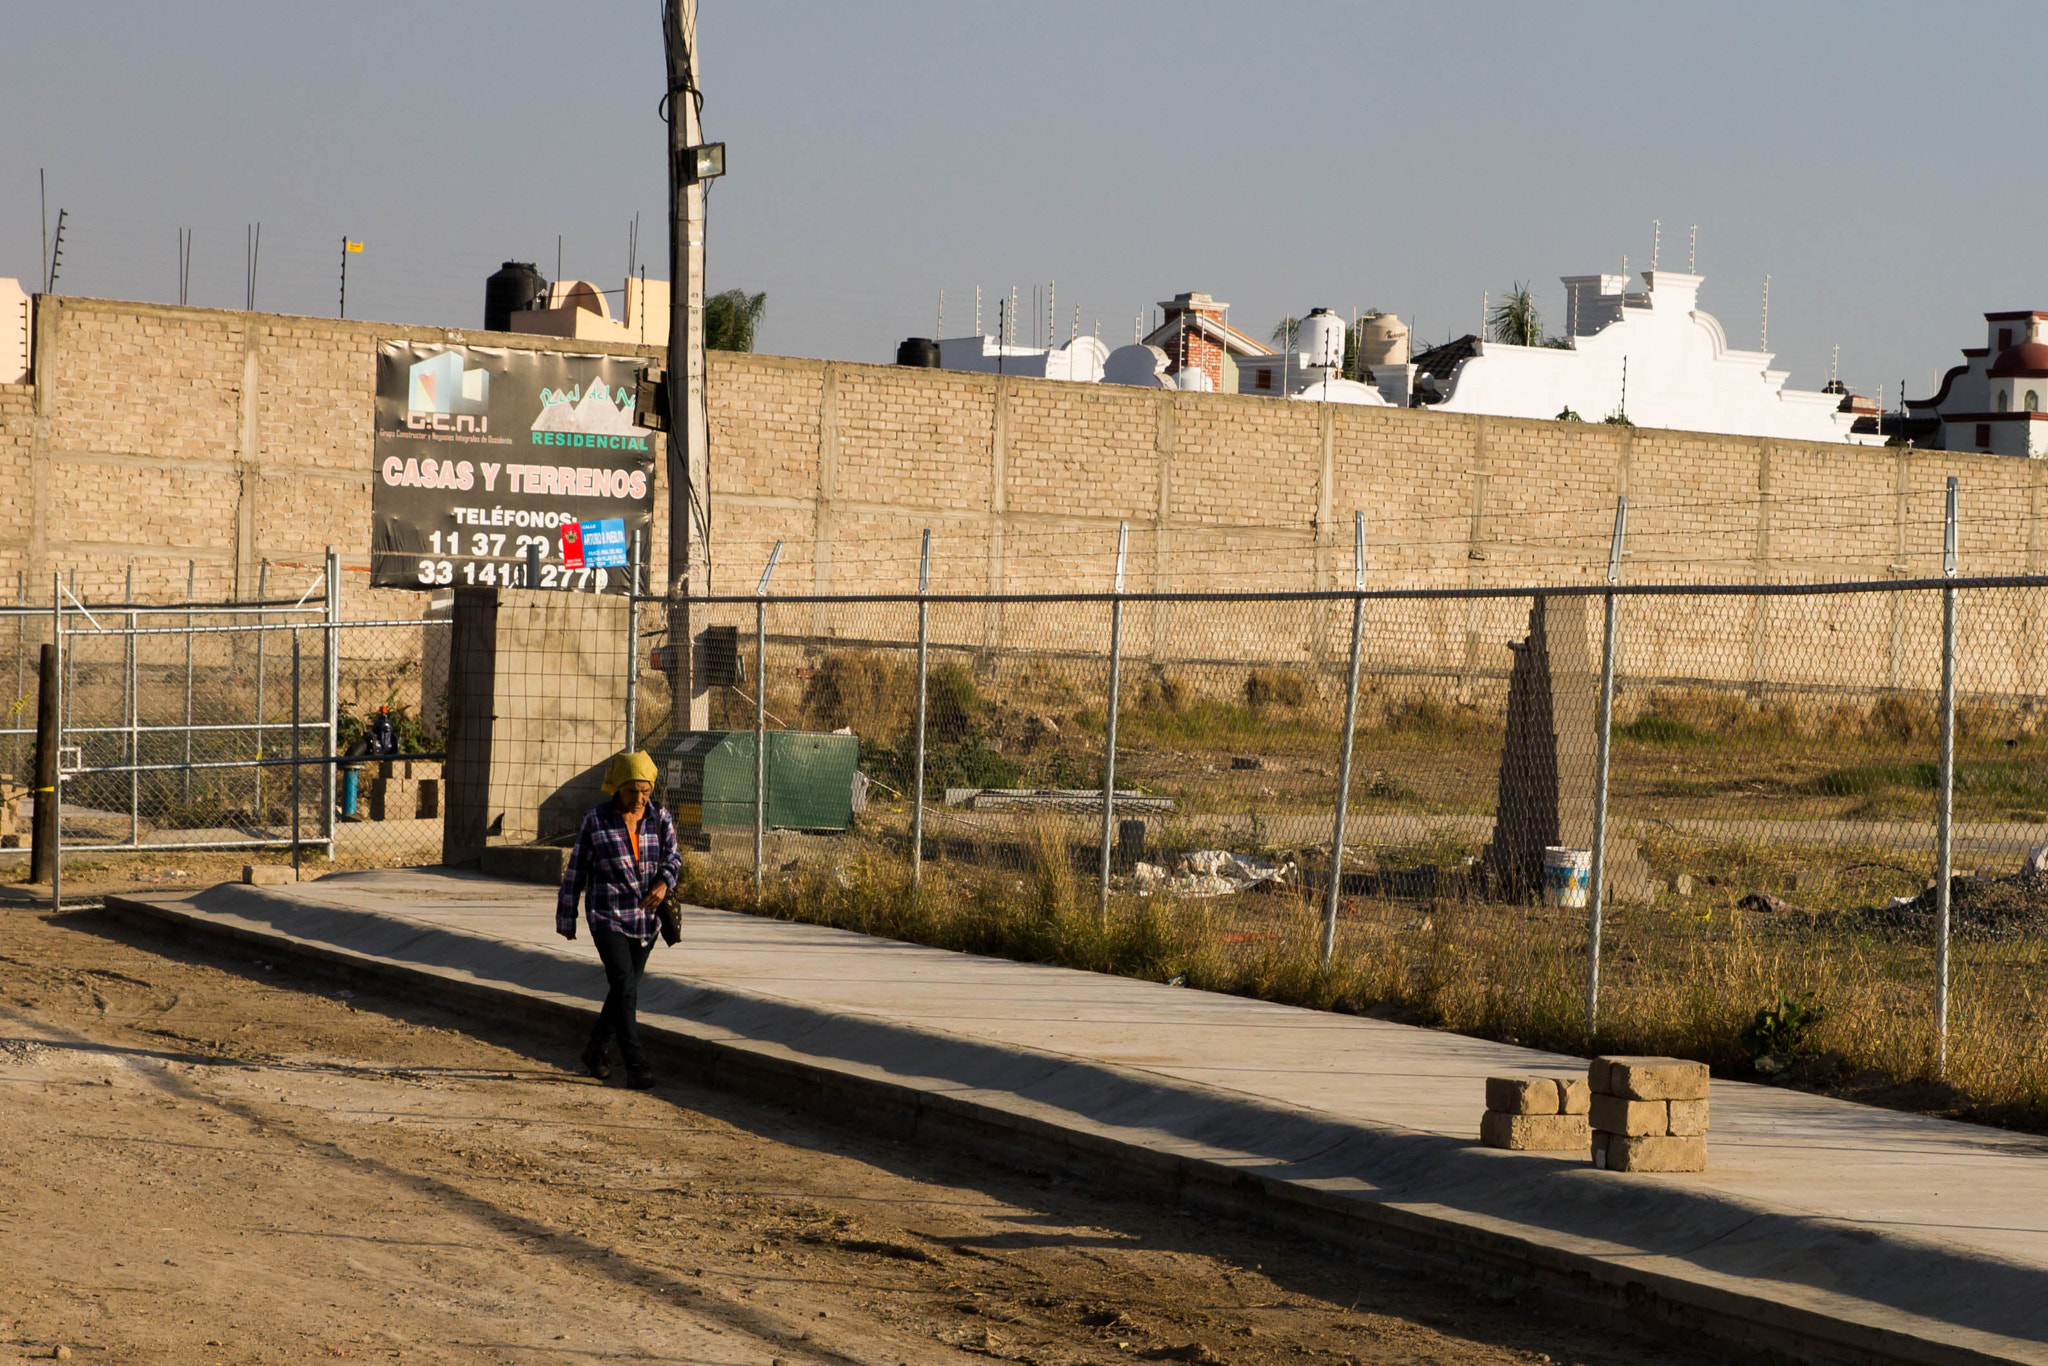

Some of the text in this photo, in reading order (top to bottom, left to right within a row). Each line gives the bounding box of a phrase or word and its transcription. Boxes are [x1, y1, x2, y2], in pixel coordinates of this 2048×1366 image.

[540, 383, 580, 408] Real
[588, 384, 610, 404] del
[396, 429, 427, 439] Constructor
[488, 435, 513, 445] Occidente
[531, 431, 649, 451] RESIDENCIAL
[382, 456, 647, 499] CASAS Y TERRENOS
[429, 530, 459, 555] 11
[471, 532, 507, 557] 37
[515, 534, 550, 559] 29
[417, 560, 453, 585] 33
